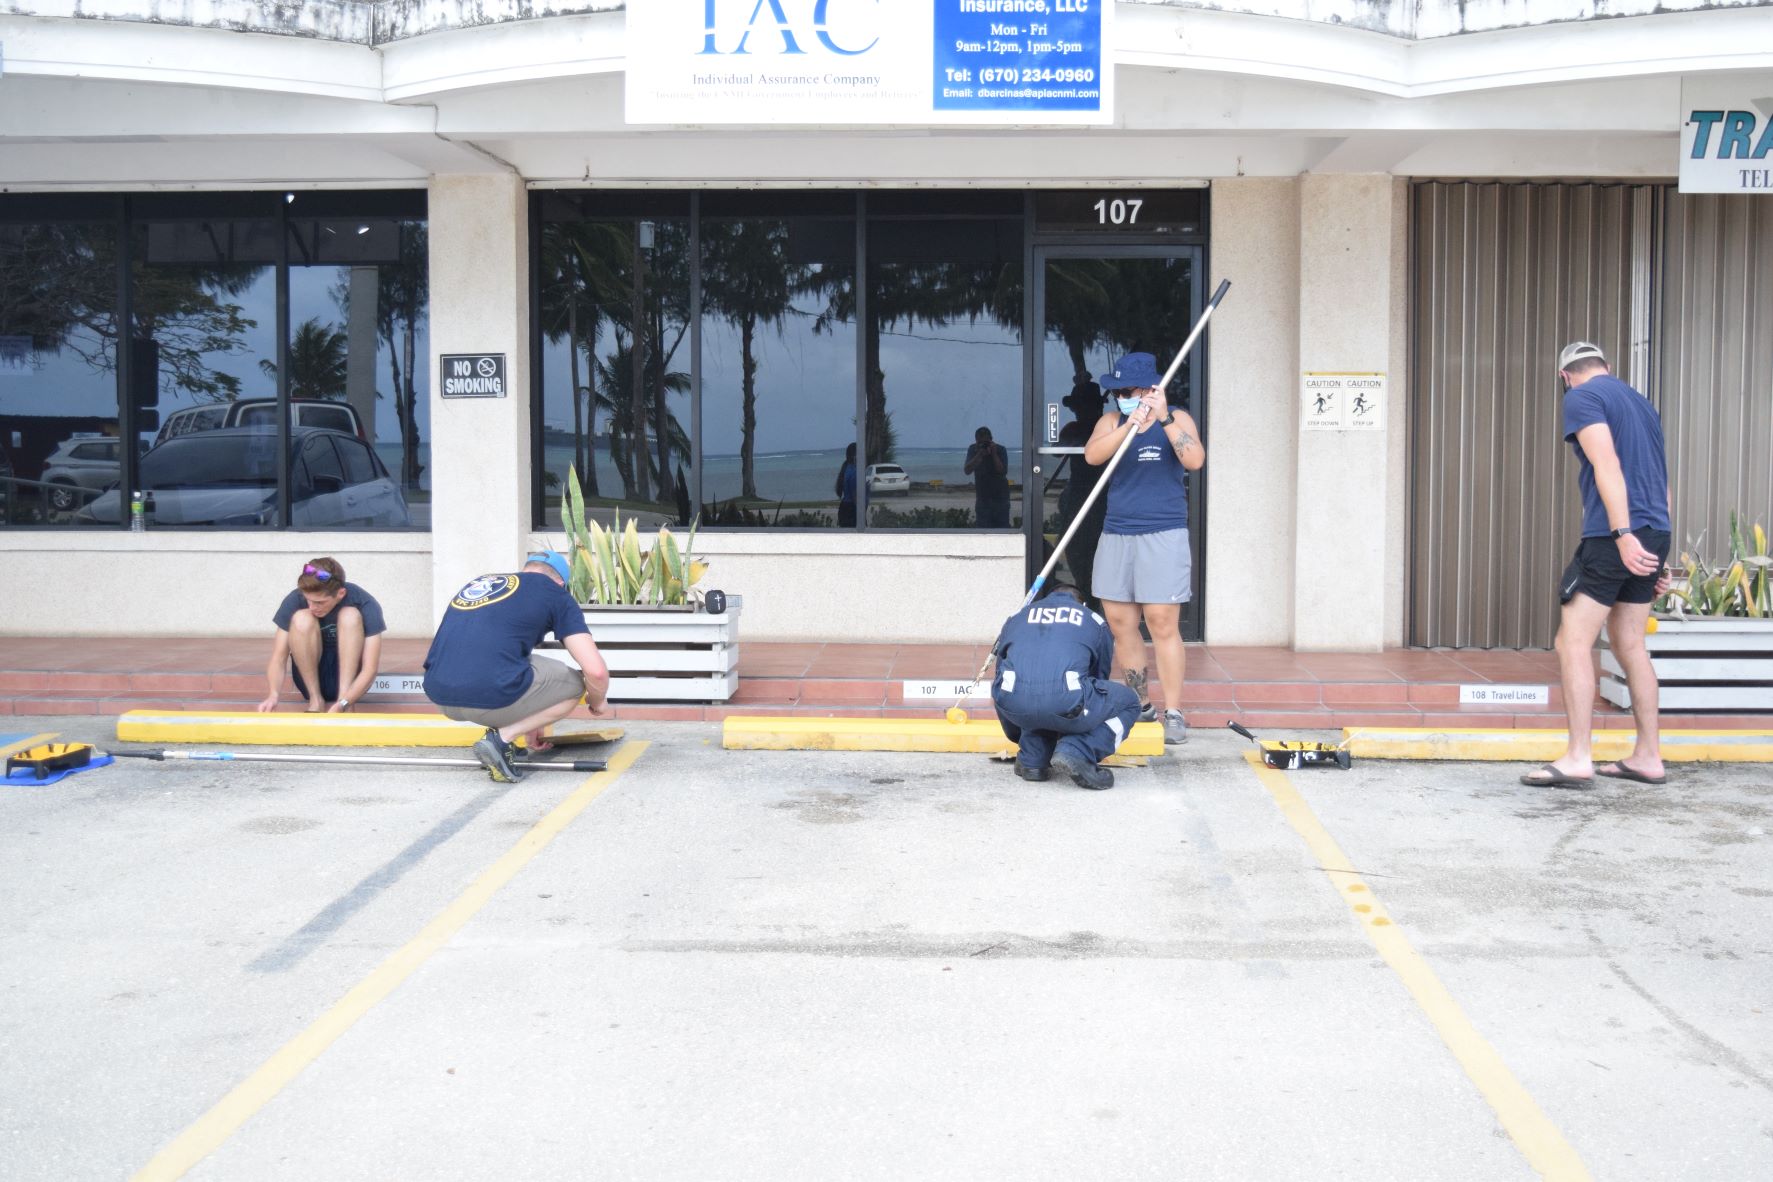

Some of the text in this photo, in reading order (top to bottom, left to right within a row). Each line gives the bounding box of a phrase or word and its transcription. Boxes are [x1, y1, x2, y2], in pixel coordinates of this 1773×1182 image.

[960, 0, 1088, 15] Insurance, LLC
[694, 0, 880, 56] IAC
[990, 24, 1018, 36] Mon
[1030, 24, 1048, 36] Fri
[956, 41, 1082, 55] 9am-12pm, 1pm-5pm
[693, 74, 881, 87] Individual Assurance Company
[945, 69, 1094, 84] Tel: (670) 234-0960
[943, 89, 973, 98] Email:
[1094, 199, 1143, 224] 107
[454, 360, 471, 376] NO
[446, 377, 502, 394] SMOKING
[1027, 607, 1084, 626] USCG
[375, 680, 424, 690] 106 PTA
[921, 685, 973, 695] 107 IAC
[1471, 690, 1537, 700] 108 Travel Lines
